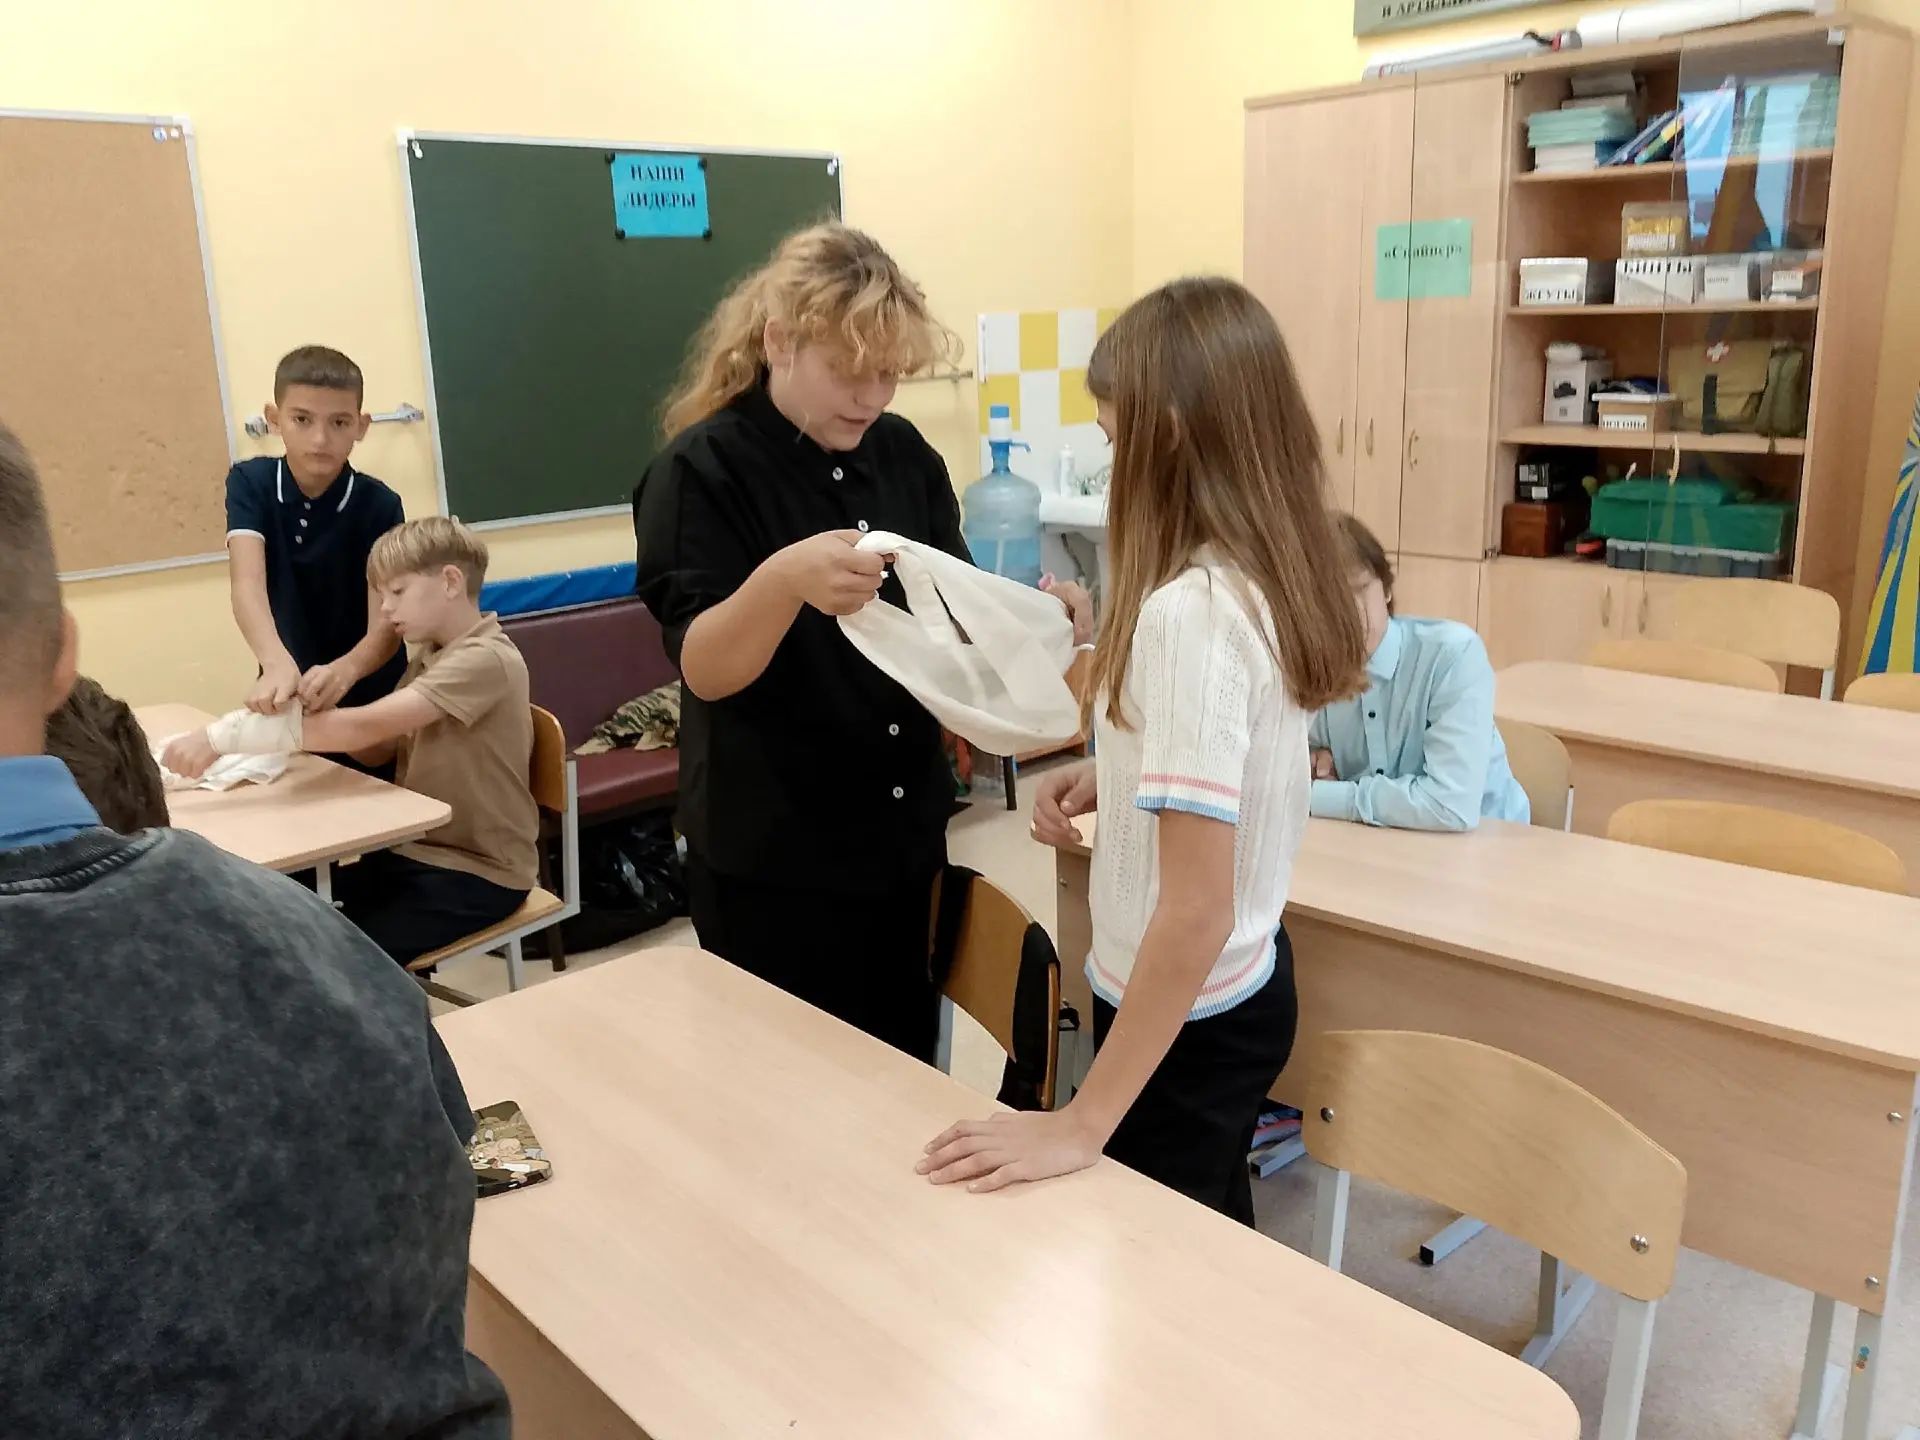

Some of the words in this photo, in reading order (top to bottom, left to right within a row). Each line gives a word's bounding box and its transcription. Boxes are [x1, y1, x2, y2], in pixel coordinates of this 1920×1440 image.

[630, 164, 684, 181] НАШИ
[623, 192, 696, 211] ЛИДЕРЫ
[1624, 261, 1692, 274] БИНТЫ
[1526, 288, 1576, 300] ЖГУТЫ
